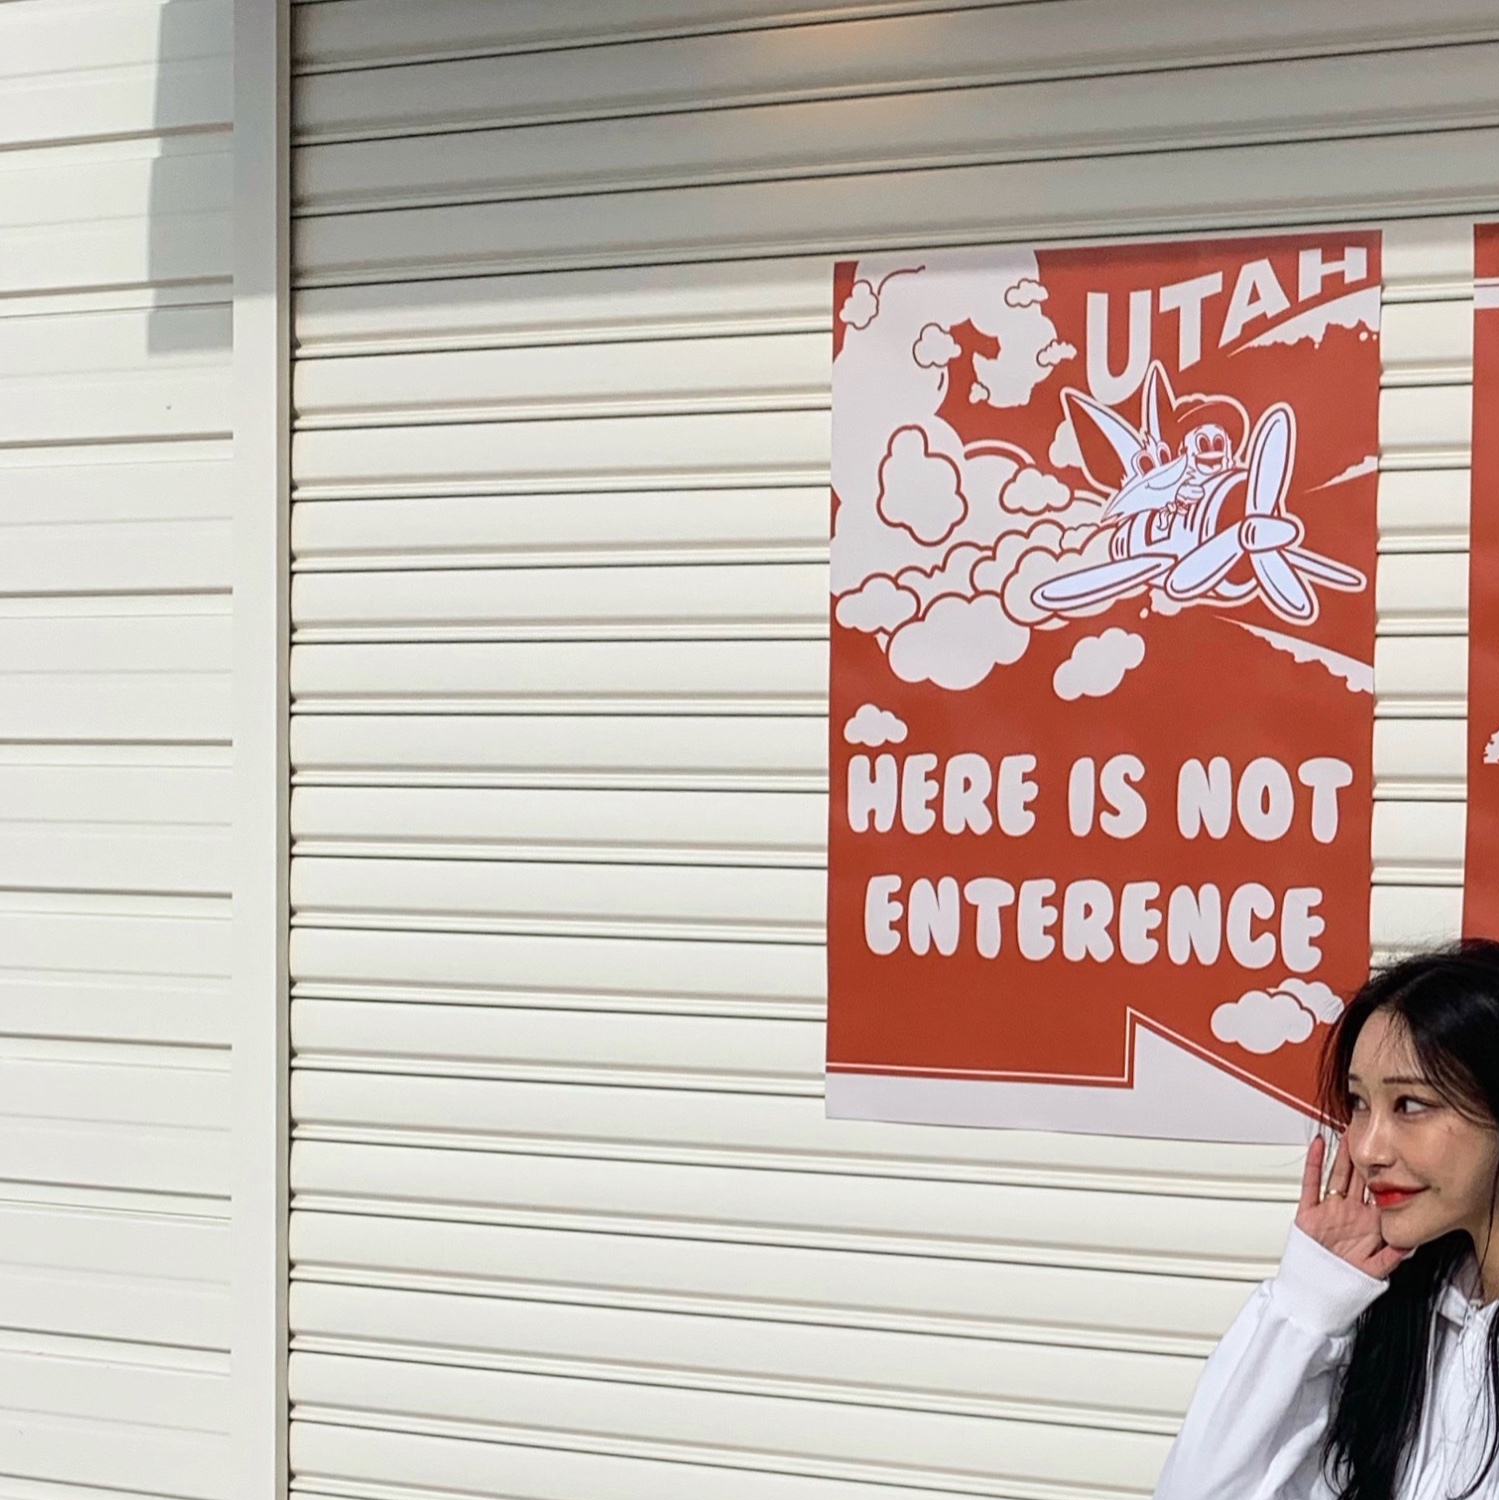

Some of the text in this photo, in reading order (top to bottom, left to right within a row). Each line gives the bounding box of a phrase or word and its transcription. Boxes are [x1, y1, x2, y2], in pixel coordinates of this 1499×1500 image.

[1086, 246, 1367, 406] UTAH
[847, 753, 1353, 844] HERE IS NOT
[864, 874, 1325, 973] ENTERENCE
